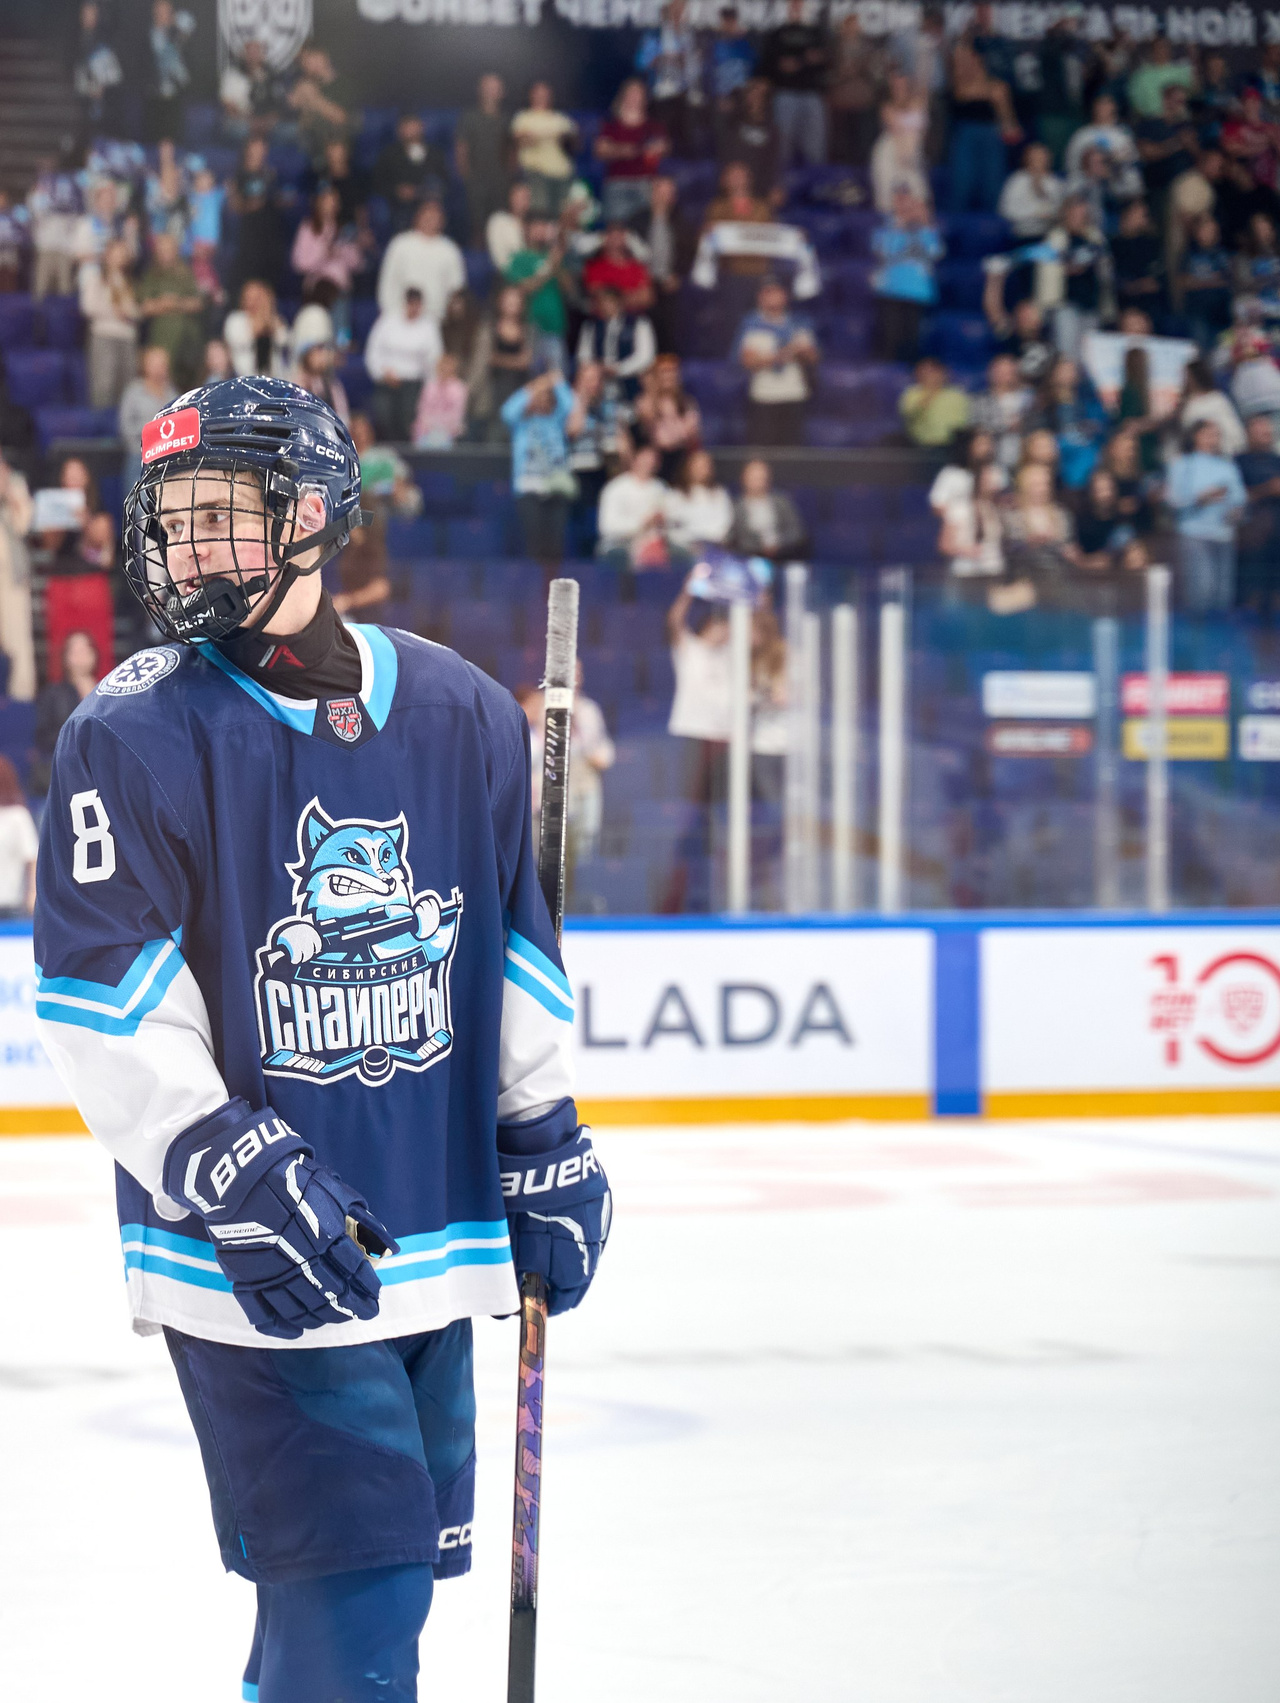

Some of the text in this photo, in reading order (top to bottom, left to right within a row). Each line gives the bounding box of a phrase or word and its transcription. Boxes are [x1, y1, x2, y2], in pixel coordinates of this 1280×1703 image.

[145, 435, 195, 459] OLIMPBET
[315, 444, 345, 464] CCM
[331, 707, 355, 717] МХЛ
[69, 788, 117, 884] 8
[312, 956, 419, 981] СИБИРСКИЕ
[580, 980, 856, 1050] LADA
[499, 1148, 599, 1197] AUER
[438, 1521, 474, 1551] CC
